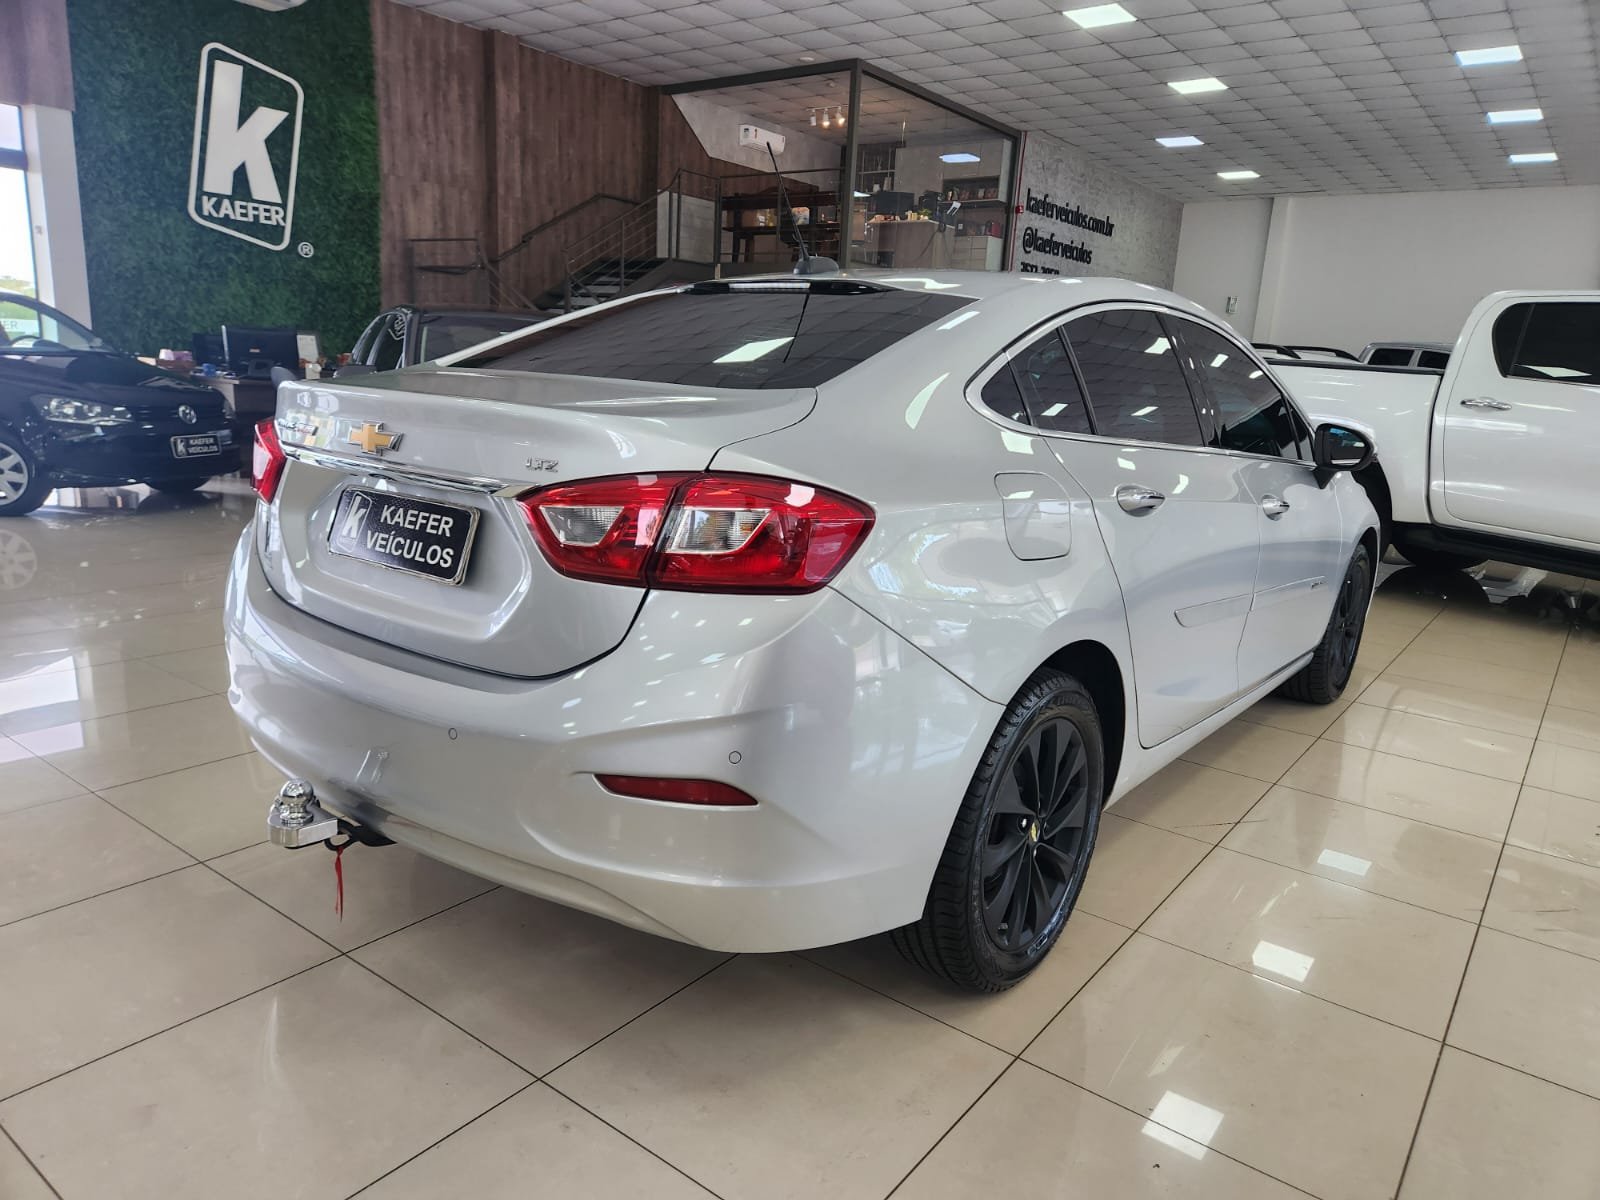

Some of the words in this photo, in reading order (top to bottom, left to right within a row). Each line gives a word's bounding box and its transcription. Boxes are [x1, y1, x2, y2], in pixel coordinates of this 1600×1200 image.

[202, 195, 286, 226] KAEFER
[380, 504, 454, 537] KAEFER
[366, 530, 454, 568] VEÍCULOS
